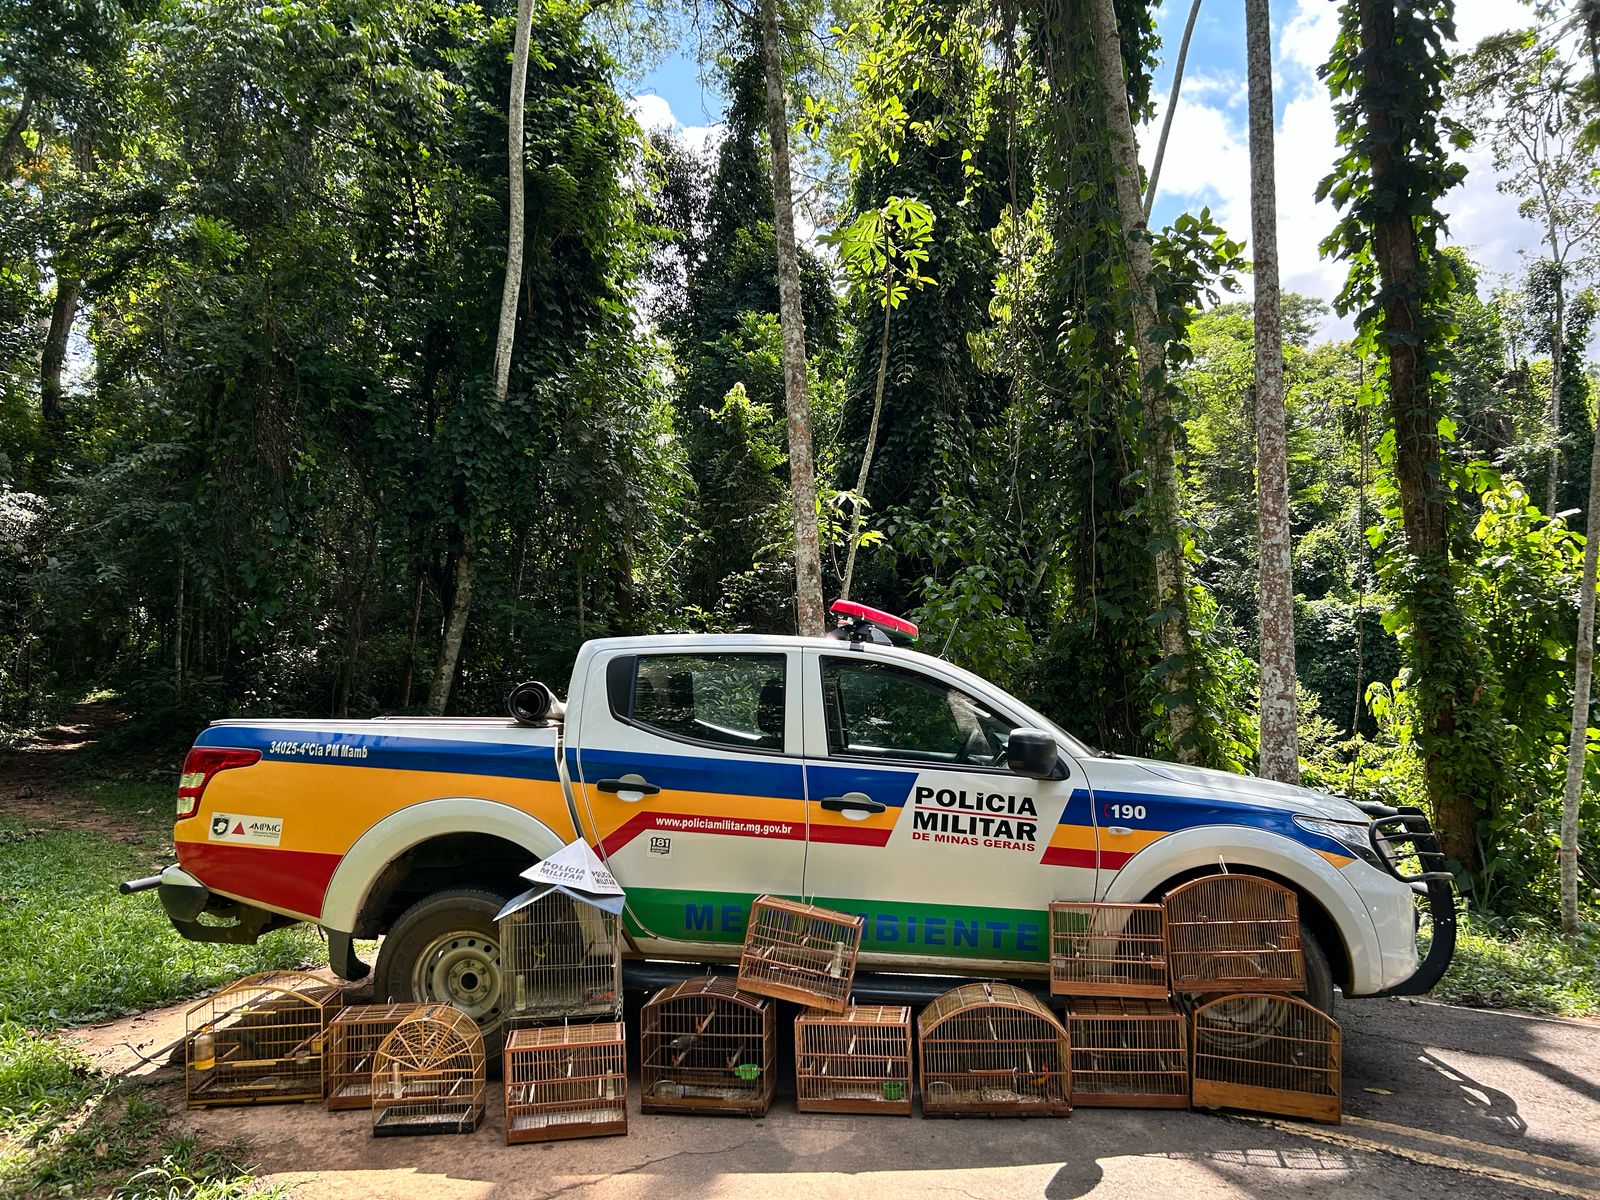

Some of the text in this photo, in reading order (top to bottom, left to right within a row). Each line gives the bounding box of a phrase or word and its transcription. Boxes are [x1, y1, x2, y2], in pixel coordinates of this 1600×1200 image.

[325, 743, 339, 757] PM
[340, 744, 368, 758] Mamb
[1111, 804, 1146, 820] 190
[656, 817, 792, 834] www.policiamilitar.mg.gov.br
[913, 811, 1037, 841] MILITAR
[651, 838, 670, 847] 181
[912, 832, 1035, 852] DE MINAS GERAIS
[540, 867, 583, 881] MILITAR
